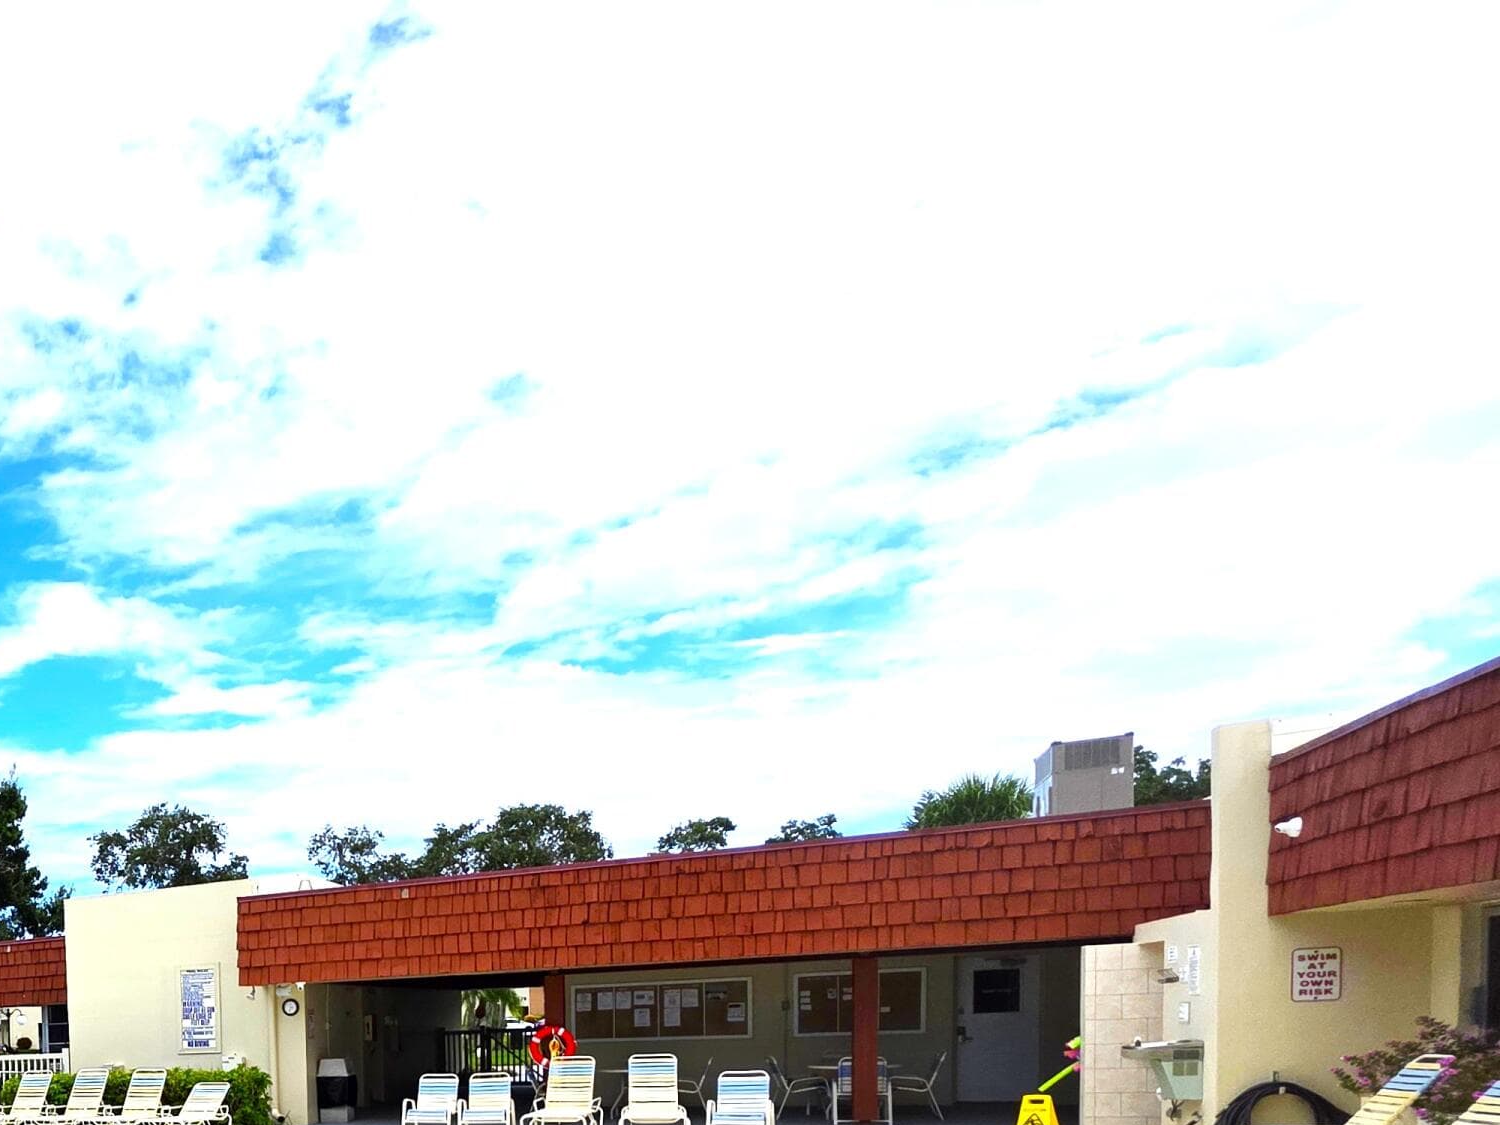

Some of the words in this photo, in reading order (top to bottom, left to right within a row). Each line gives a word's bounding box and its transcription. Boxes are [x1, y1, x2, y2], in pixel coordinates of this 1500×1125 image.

[1297, 953, 1337, 961] SWIM
[1297, 970, 1337, 978] YOUR
[1299, 988, 1333, 996] RISK
